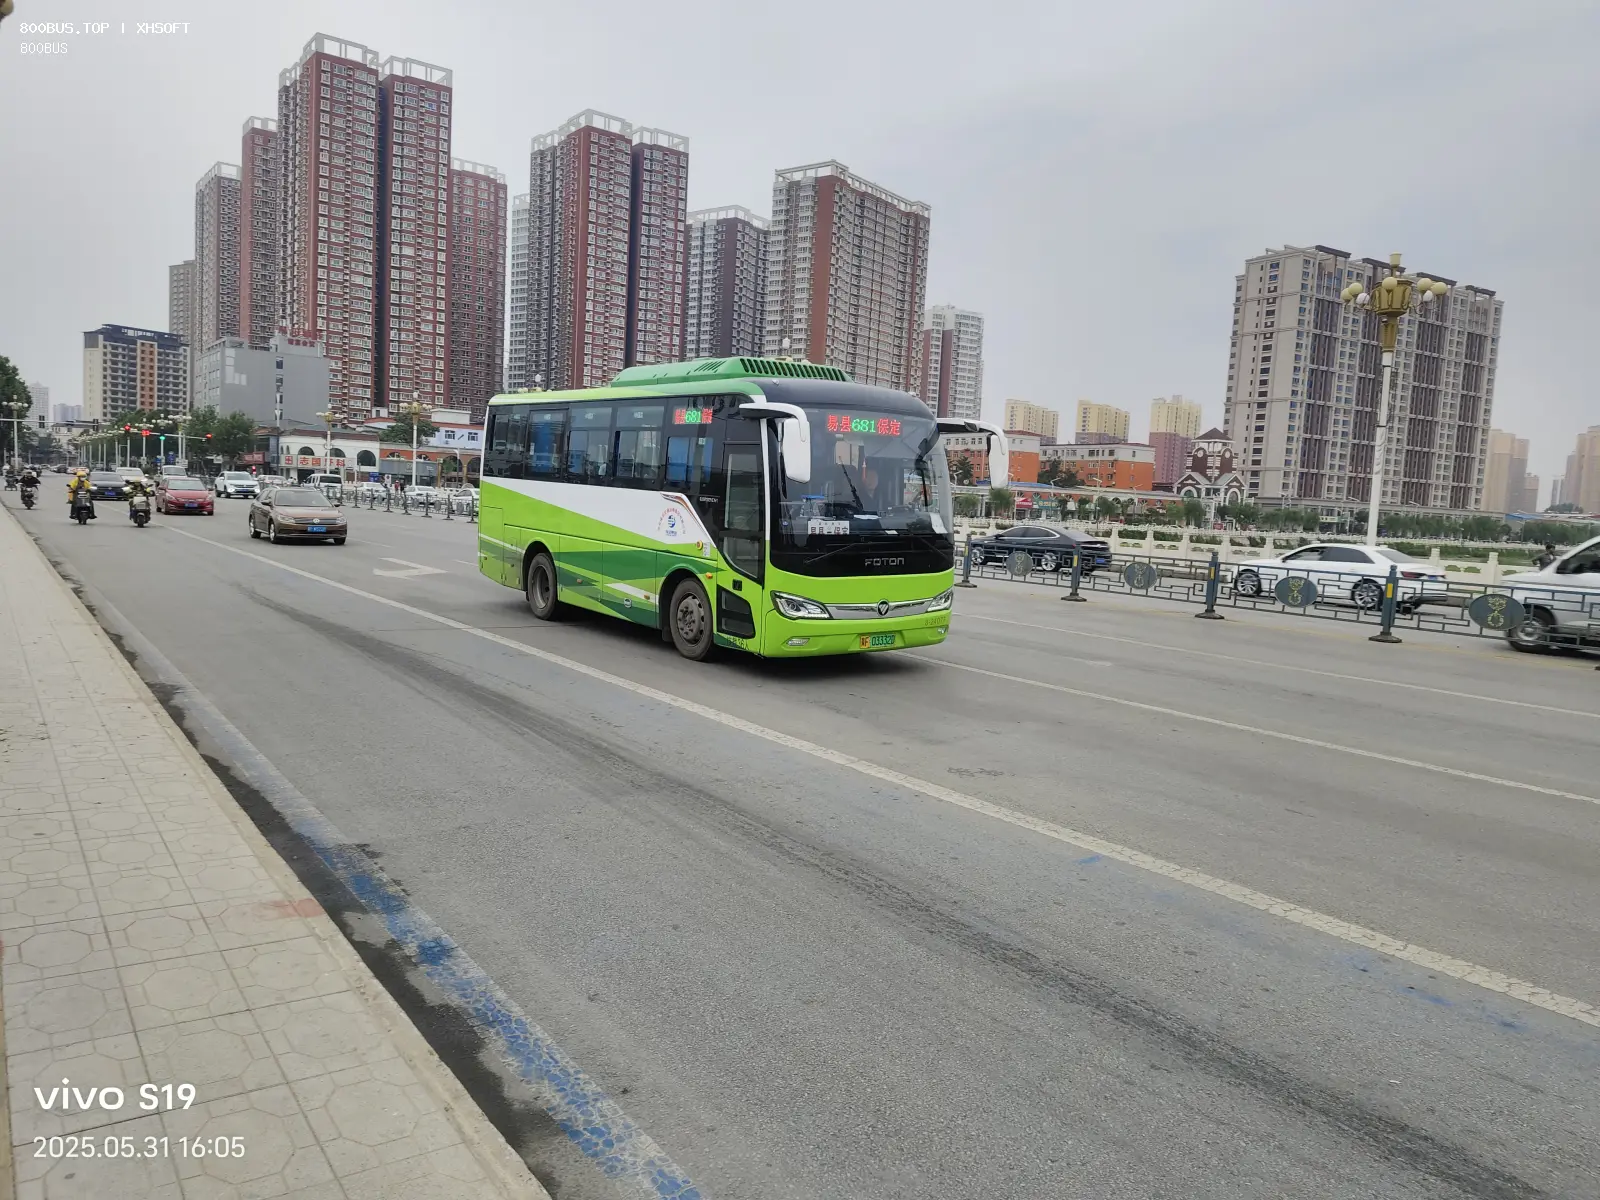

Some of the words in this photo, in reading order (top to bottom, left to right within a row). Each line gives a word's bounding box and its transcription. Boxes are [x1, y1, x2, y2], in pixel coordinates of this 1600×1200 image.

[827, 414, 902, 436] 易县681保定
[864, 557, 905, 567] FOTON
